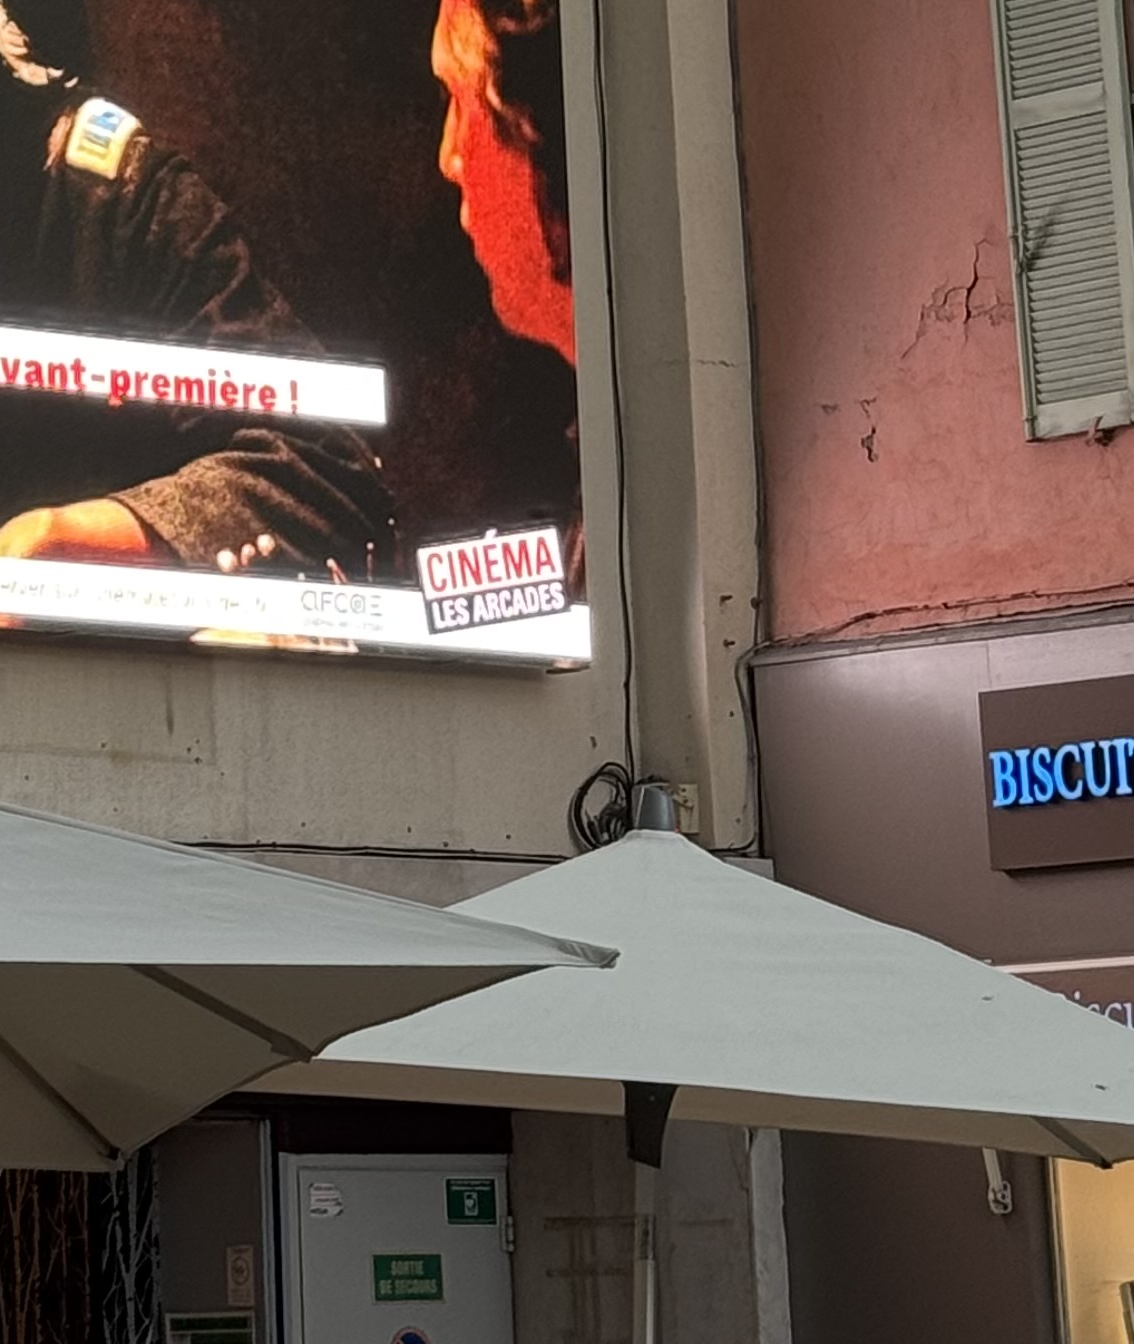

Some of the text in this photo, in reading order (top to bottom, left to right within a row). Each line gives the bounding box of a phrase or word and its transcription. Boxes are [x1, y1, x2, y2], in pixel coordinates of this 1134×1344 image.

[287, 379, 299, 414] !
[426, 528, 557, 593] CINÉMA
[429, 581, 565, 630] LES ARCADES
